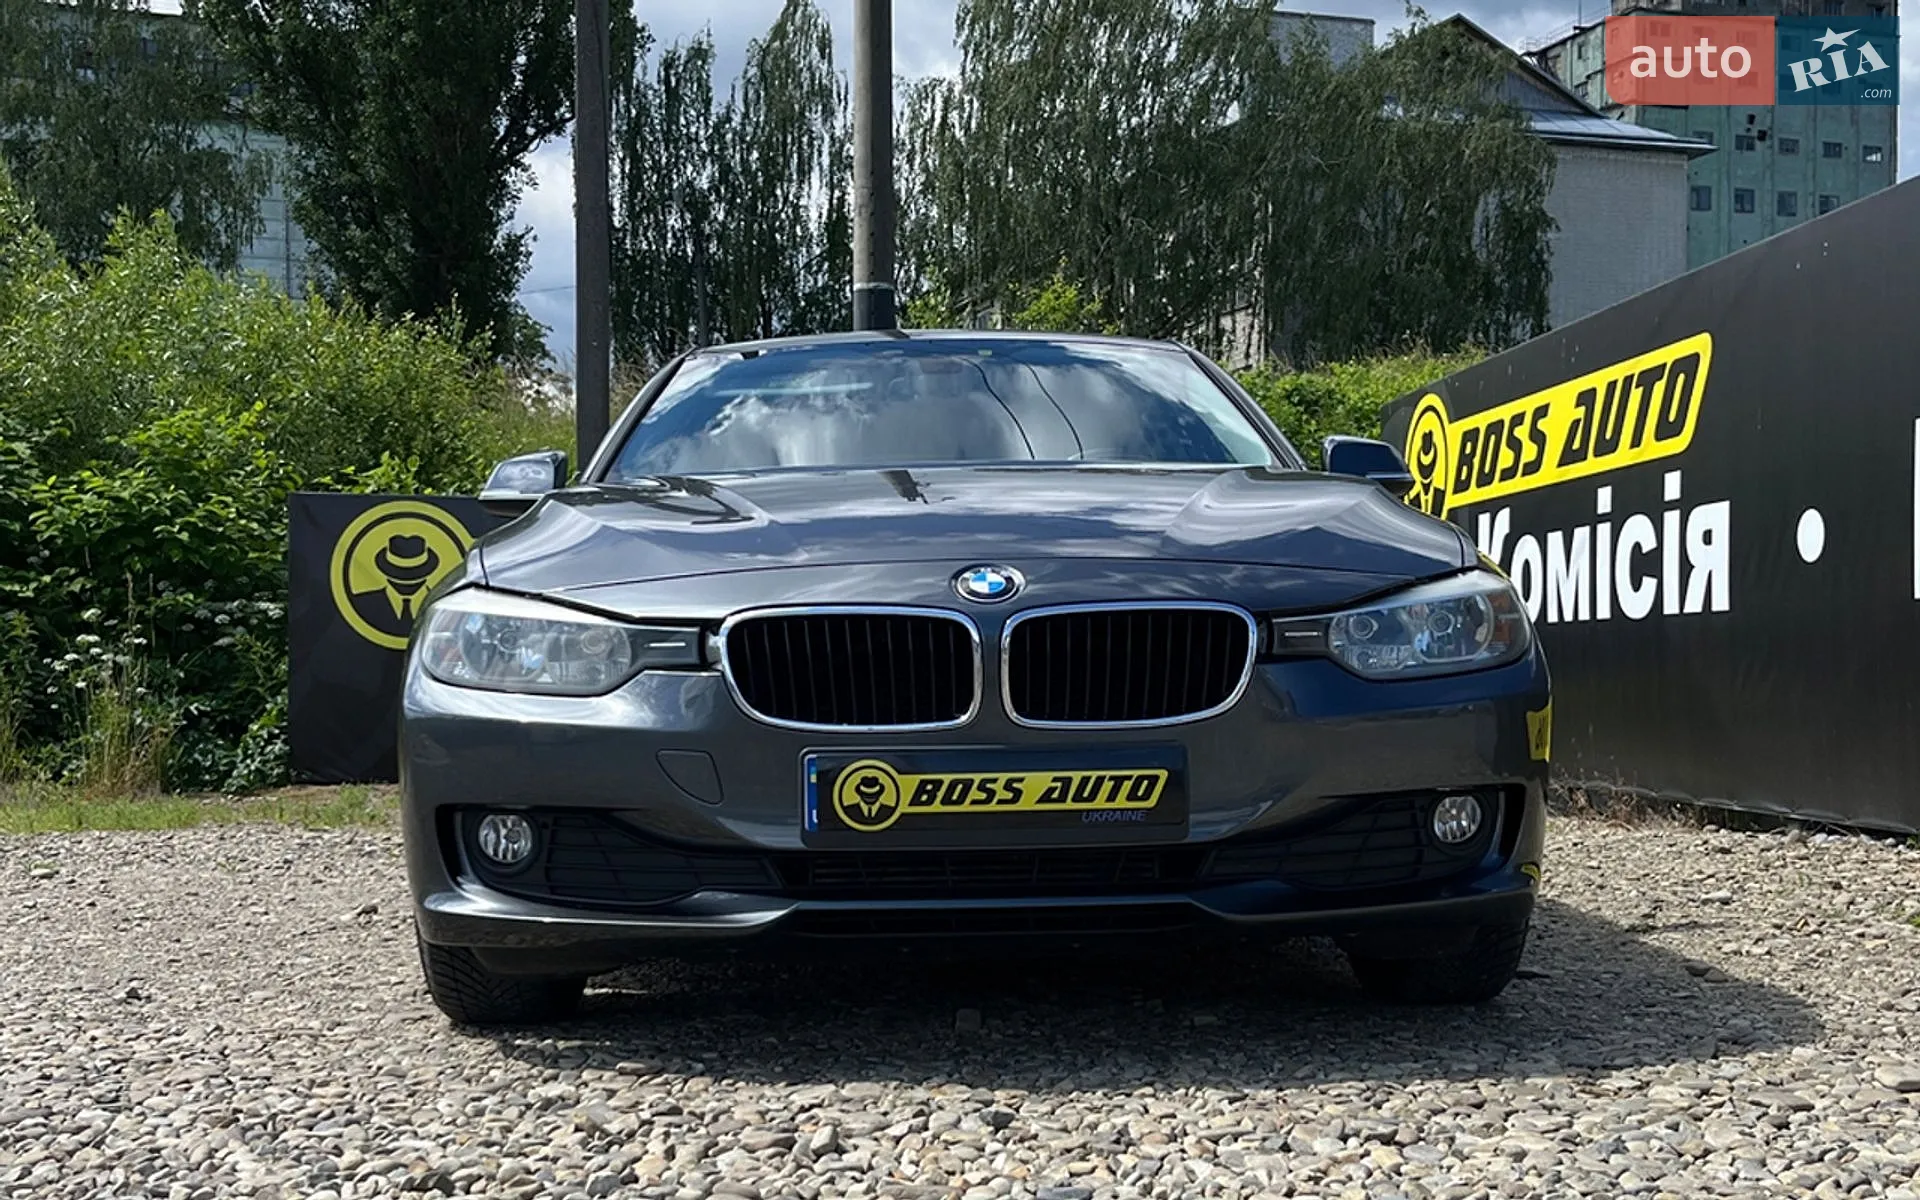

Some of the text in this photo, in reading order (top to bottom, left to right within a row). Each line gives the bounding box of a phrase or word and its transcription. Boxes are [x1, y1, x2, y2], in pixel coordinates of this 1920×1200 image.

[1453, 353, 1701, 493] BOSS AUTO
[908, 774, 1162, 807] BOSS AUTO
[1081, 810, 1147, 822] UKRAINE
